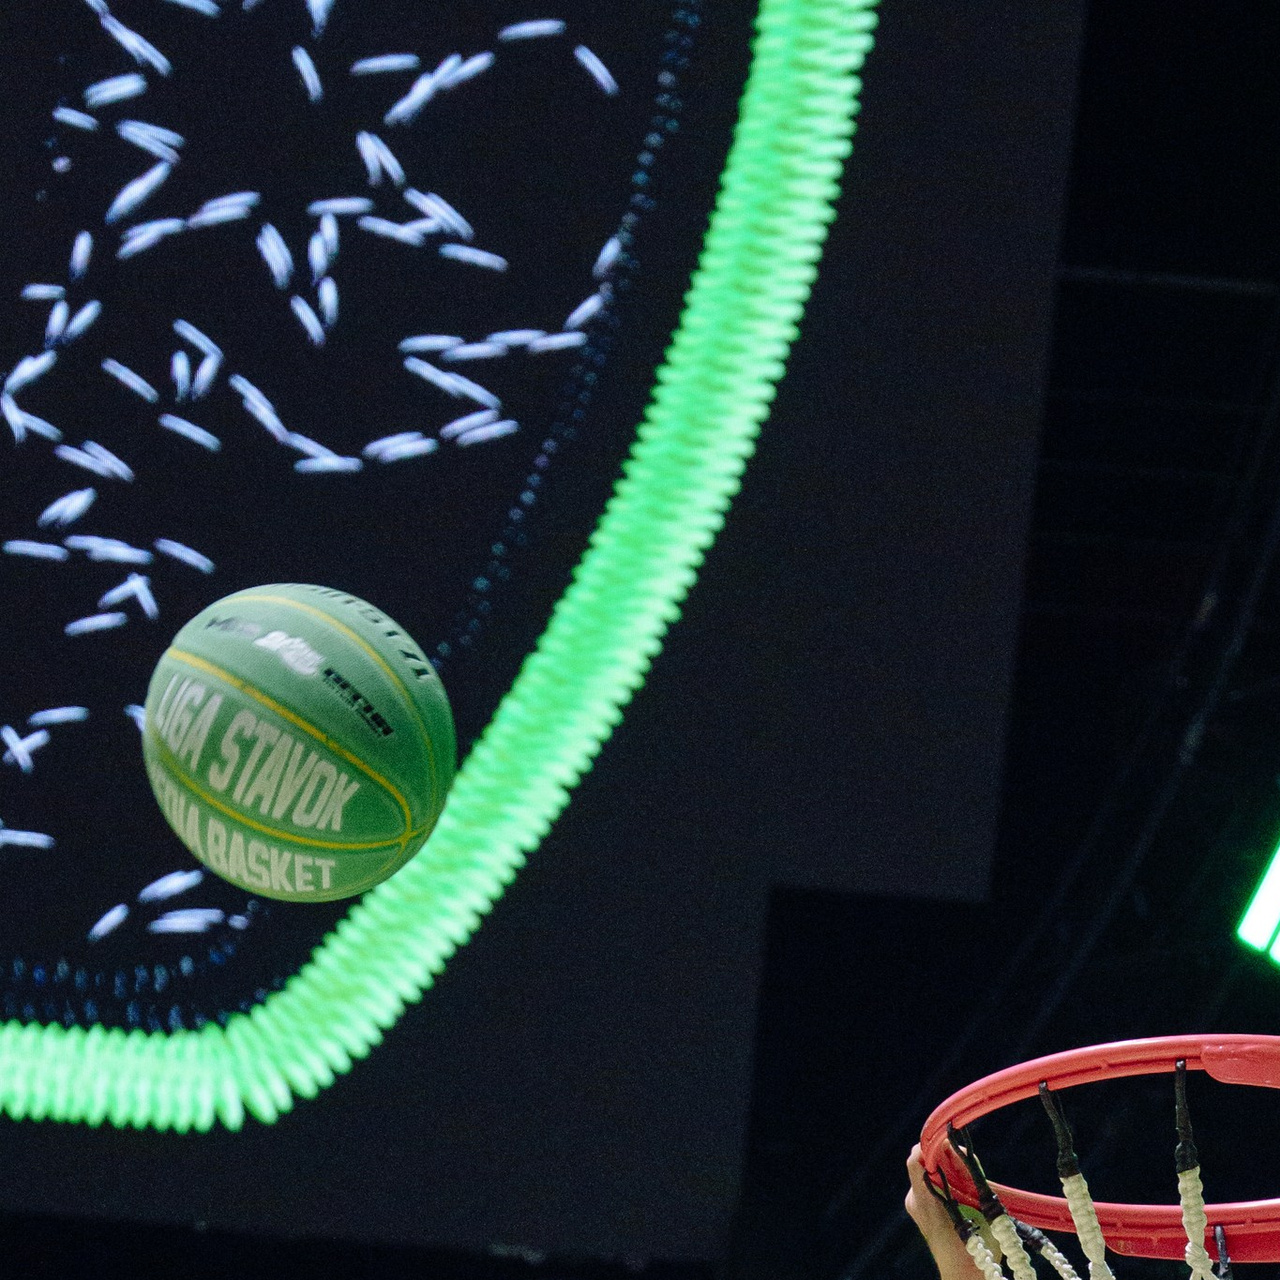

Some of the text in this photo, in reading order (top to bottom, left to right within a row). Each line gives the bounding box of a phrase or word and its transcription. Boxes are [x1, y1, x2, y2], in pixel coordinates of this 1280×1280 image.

[155, 673, 224, 772] LIGA
[208, 709, 361, 832] STAVOK
[207, 818, 336, 893] BASKET
